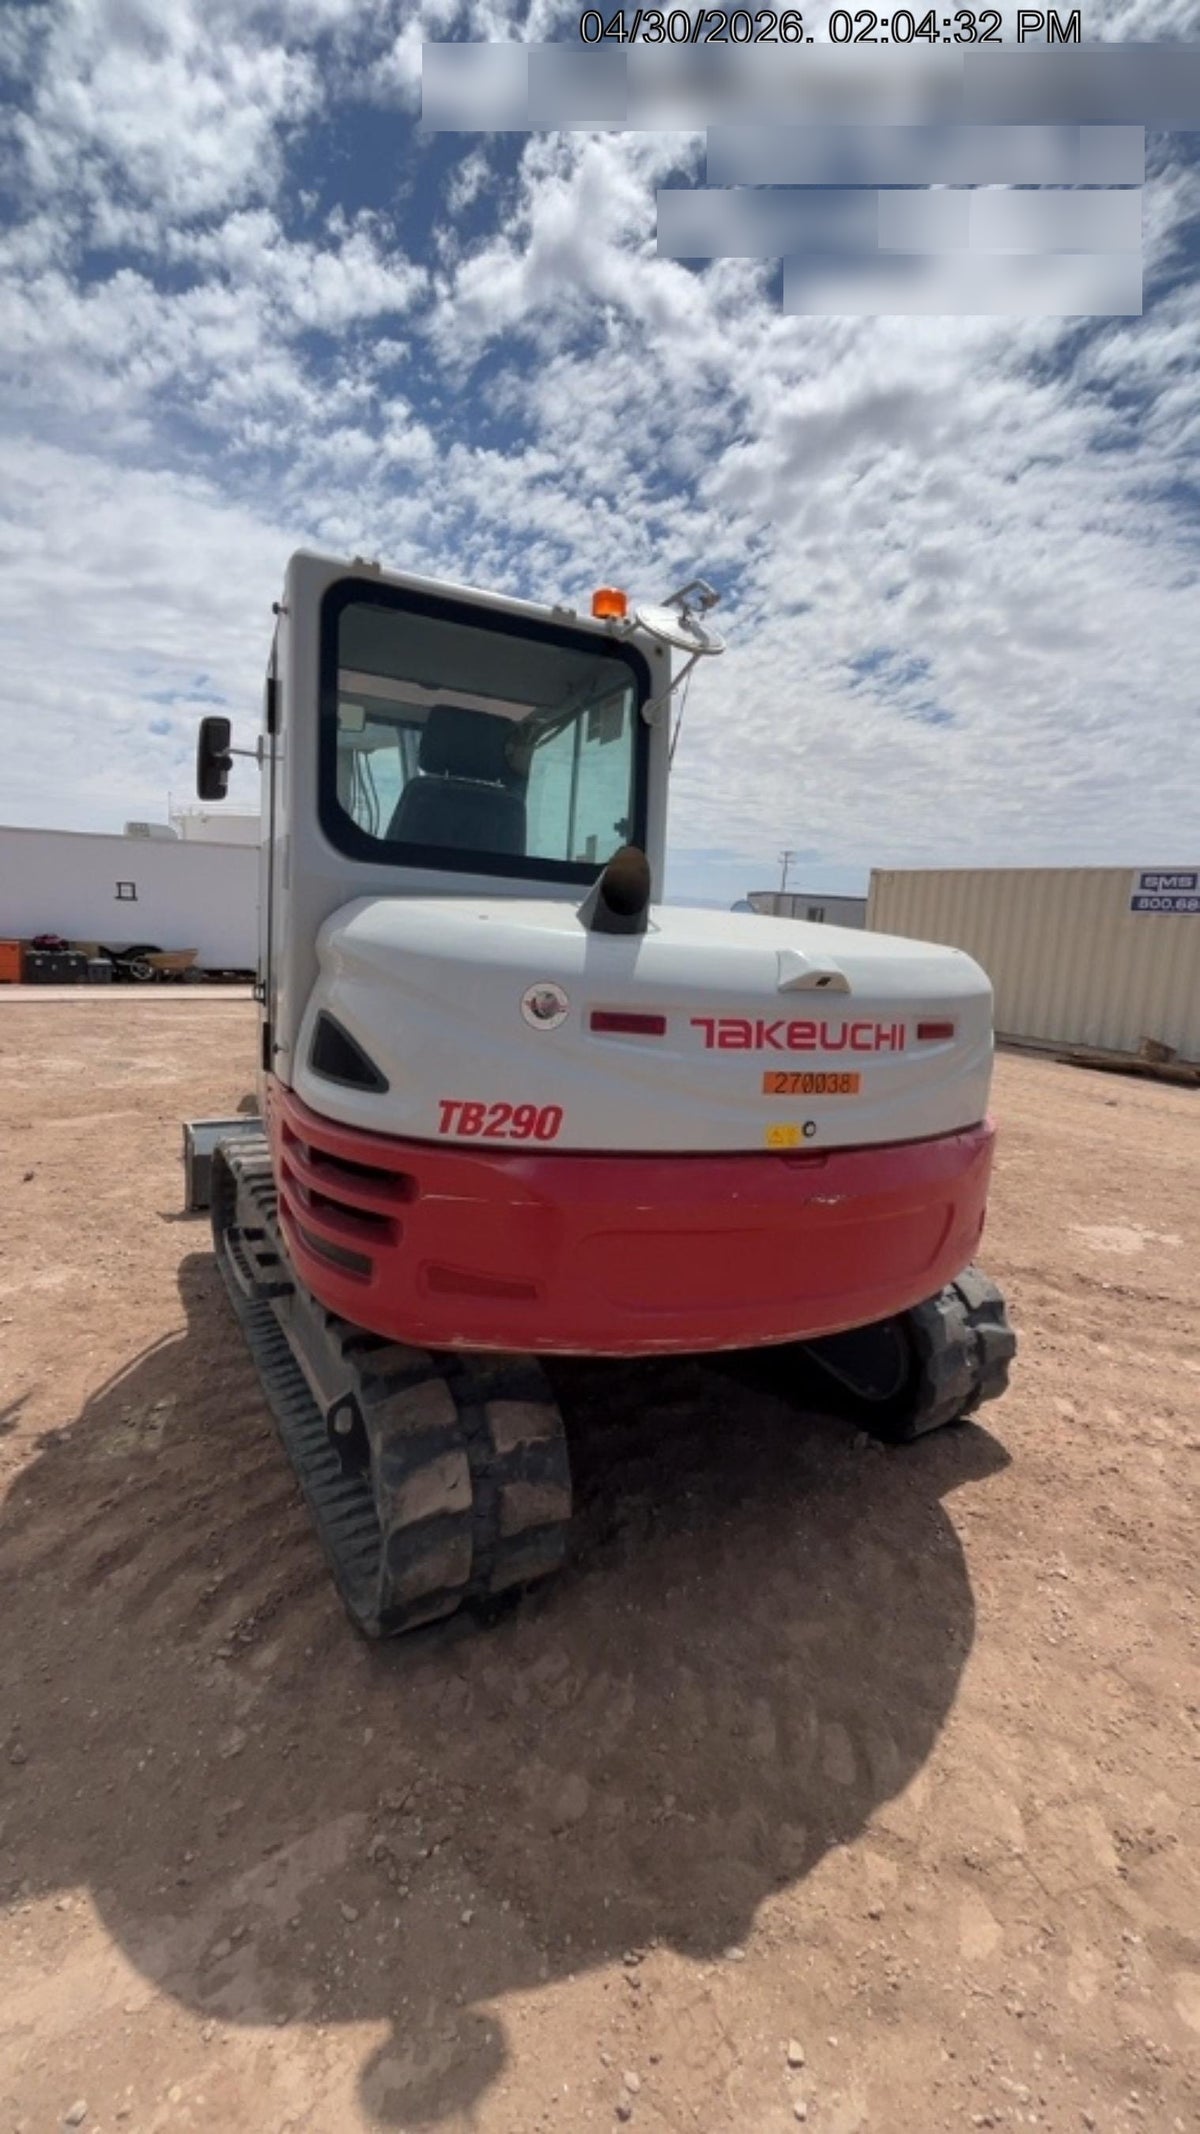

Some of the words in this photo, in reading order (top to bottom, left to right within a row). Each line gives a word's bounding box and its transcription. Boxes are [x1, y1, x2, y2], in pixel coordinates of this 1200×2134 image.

[1144, 876, 1194, 889] SMS
[690, 1017, 905, 1050] TAKEUCHI
[774, 1072, 850, 1094] 270038
[438, 1100, 563, 1141] TB290
